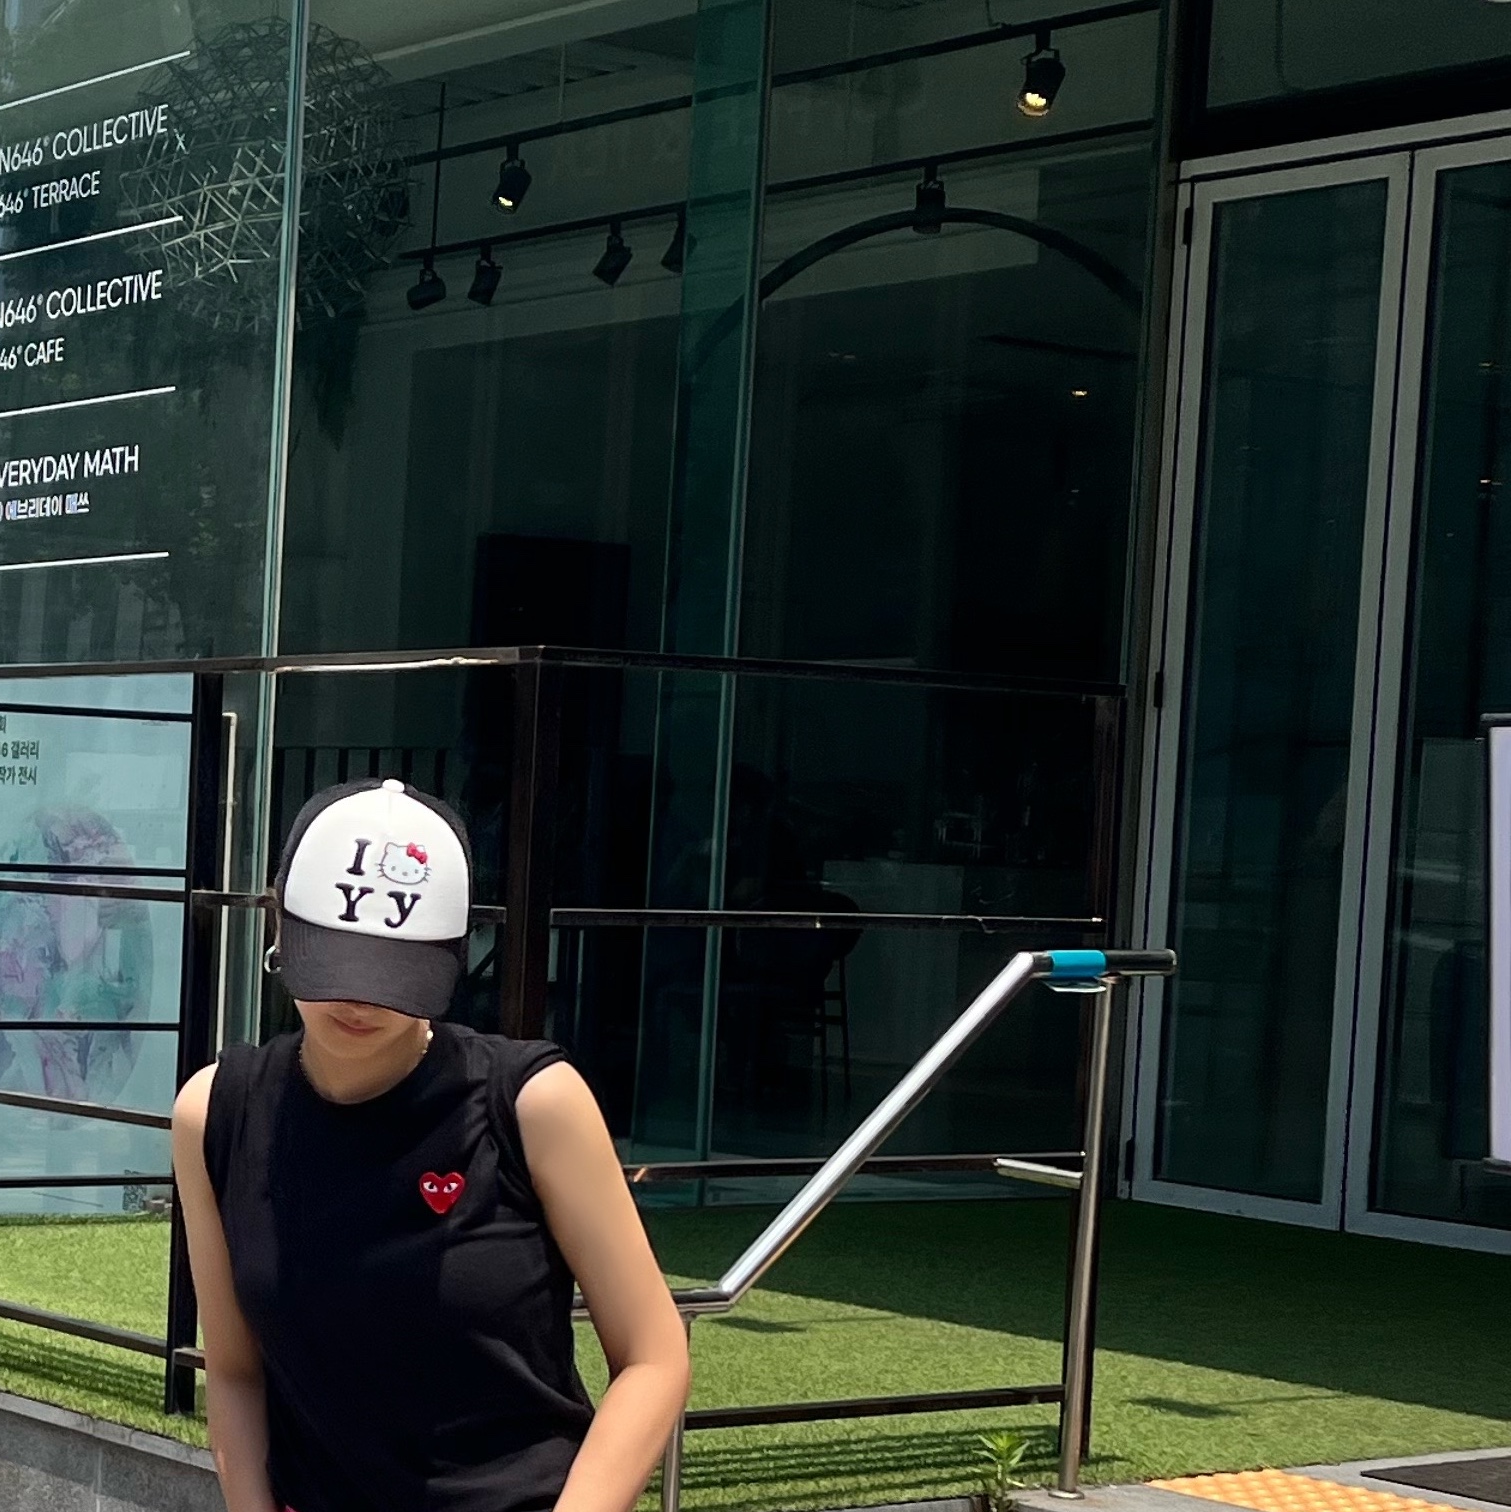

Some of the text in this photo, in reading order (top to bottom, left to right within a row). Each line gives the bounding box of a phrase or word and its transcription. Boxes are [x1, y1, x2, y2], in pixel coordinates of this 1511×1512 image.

[52, 104, 169, 161] COLLECTIVE
[32, 170, 101, 209] TERRACE
[46, 269, 163, 319] COLLECTIVE
[24, 338, 65, 366] CAFE
[84, 444, 139, 478] MATH
[10, 740, 40, 760] 갤러리
[17, 765, 38, 786] 전시
[346, 838, 372, 876] I
